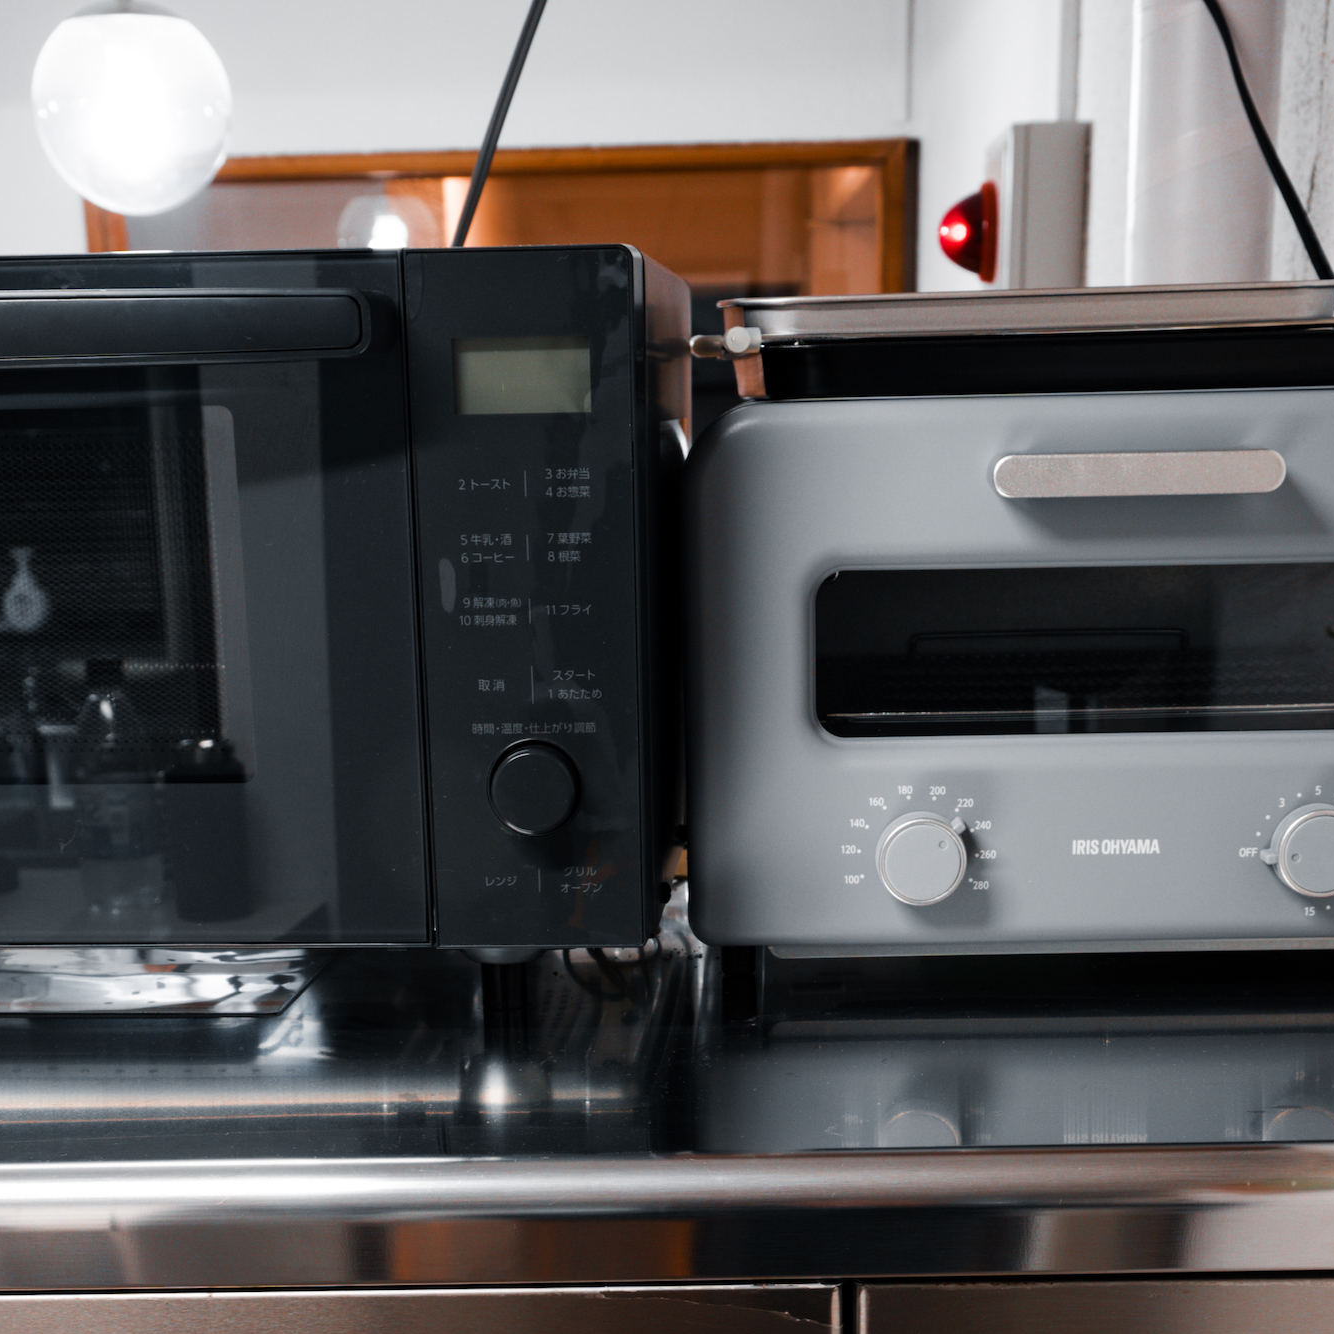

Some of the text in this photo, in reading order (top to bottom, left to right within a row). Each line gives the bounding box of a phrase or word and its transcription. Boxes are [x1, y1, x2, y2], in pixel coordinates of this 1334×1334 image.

[545, 467, 590, 480] 3 お弁当
[458, 478, 511, 490] 2 トースト
[545, 485, 590, 498] 4 お惣菜
[460, 533, 512, 546] 5 牛乳・酒
[547, 532, 592, 544] 7 葉野菜
[460, 552, 515, 563] 6 コーヒー
[548, 550, 581, 562] 8 根菜
[463, 597, 471, 608] 9
[546, 604, 592, 615] 11 フライ
[460, 614, 517, 627] 10 刺身解凍
[553, 669, 596, 681] スタート
[558, 688, 603, 699] あたため
[472, 721, 597, 735] 時間・温度・仕上がり調節
[897, 785, 913, 795] 180
[929, 786, 946, 795] 200
[1315, 785, 1322, 795] 5
[869, 797, 884, 807] 160
[957, 798, 974, 808] 220
[1278, 797, 1286, 808] 3
[850, 818, 865, 828] 140
[975, 820, 991, 830] 240
[841, 845, 856, 854] 120
[1072, 839, 1160, 855] IRIS OHYAMA
[1239, 847, 1258, 858] OFF
[979, 850, 997, 860] 260
[564, 866, 597, 877] グリル
[485, 876, 518, 887] レンジ
[844, 875, 860, 884] 100
[560, 882, 603, 893] オーブン
[973, 881, 989, 890] 280
[1304, 906, 1316, 917] 15
